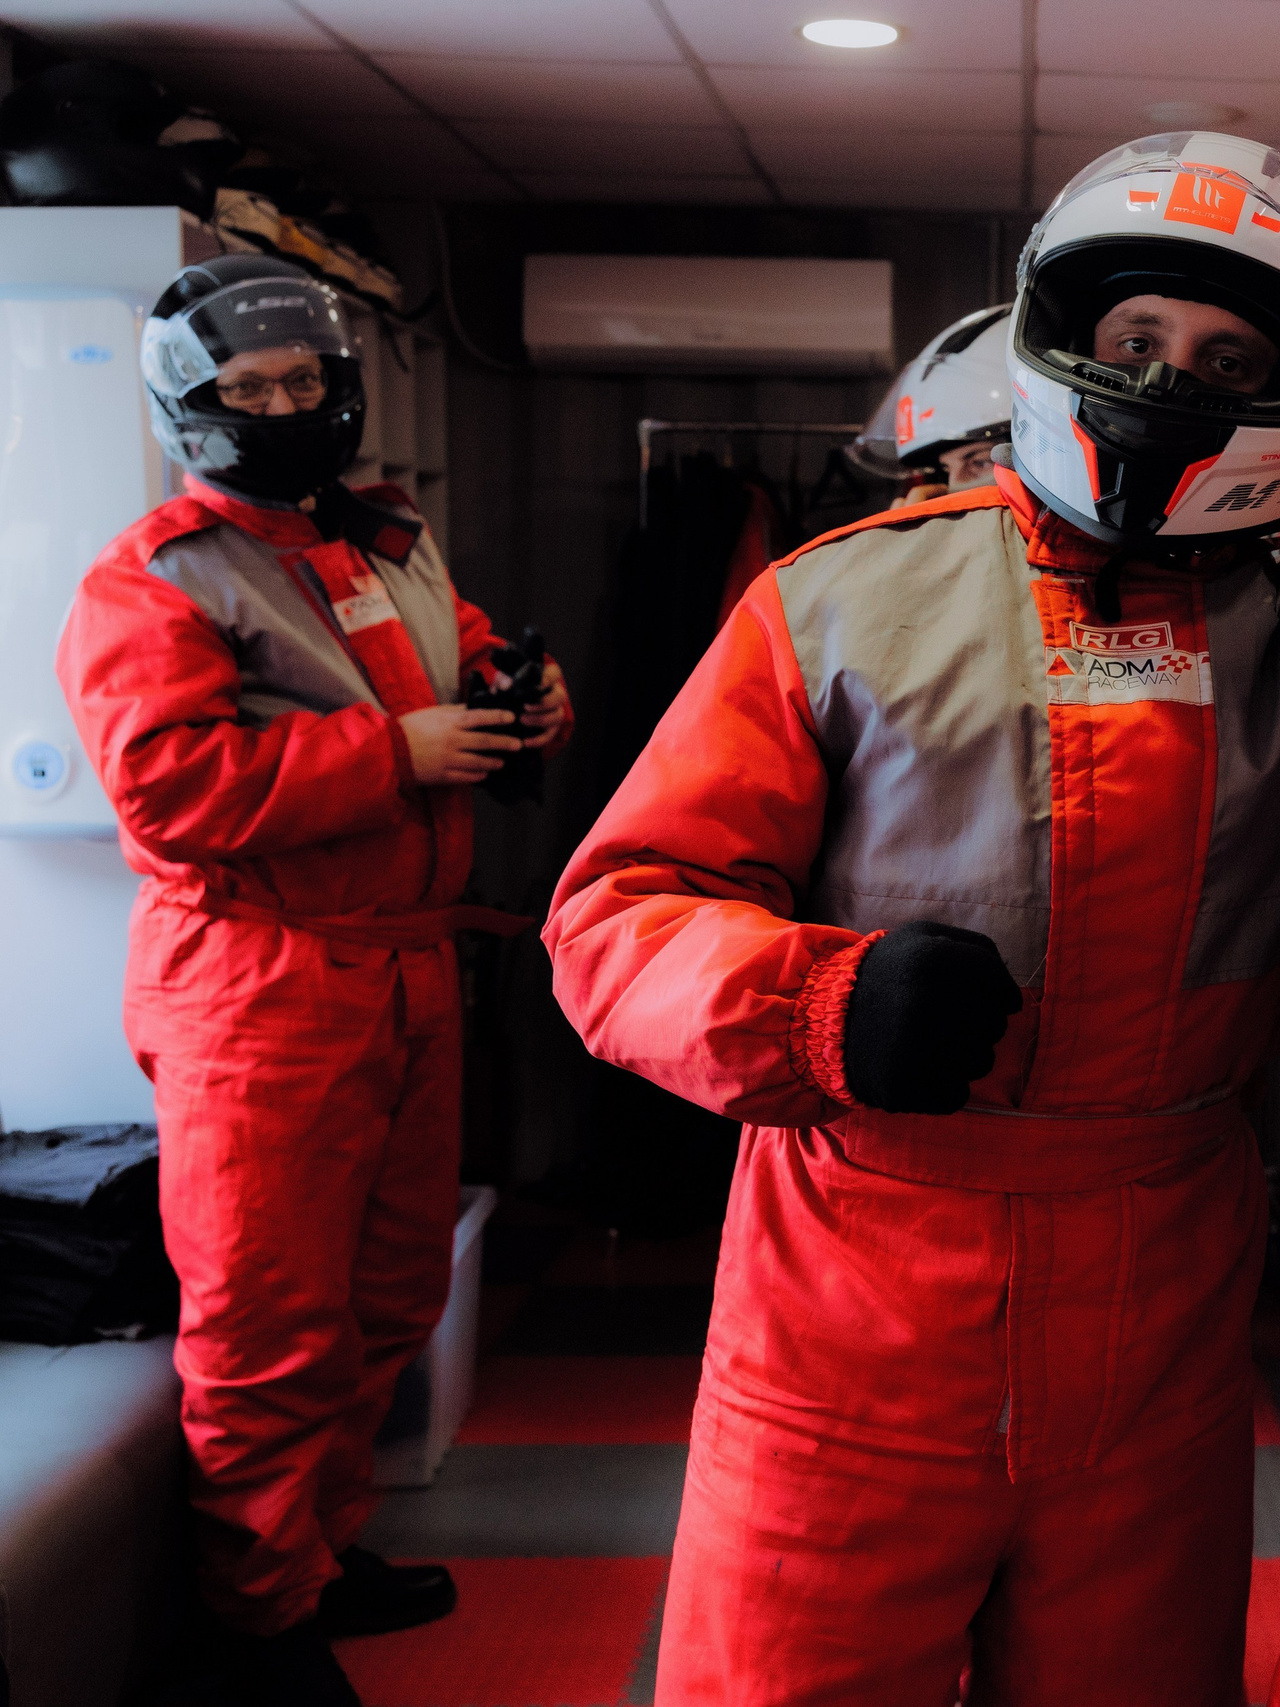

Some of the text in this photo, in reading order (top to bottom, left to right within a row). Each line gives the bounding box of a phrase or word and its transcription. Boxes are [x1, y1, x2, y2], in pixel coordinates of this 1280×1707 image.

[1081, 631, 1161, 650] RLG
[1088, 658, 1155, 679] ADM
[1088, 672, 1181, 691] RACEWAY
